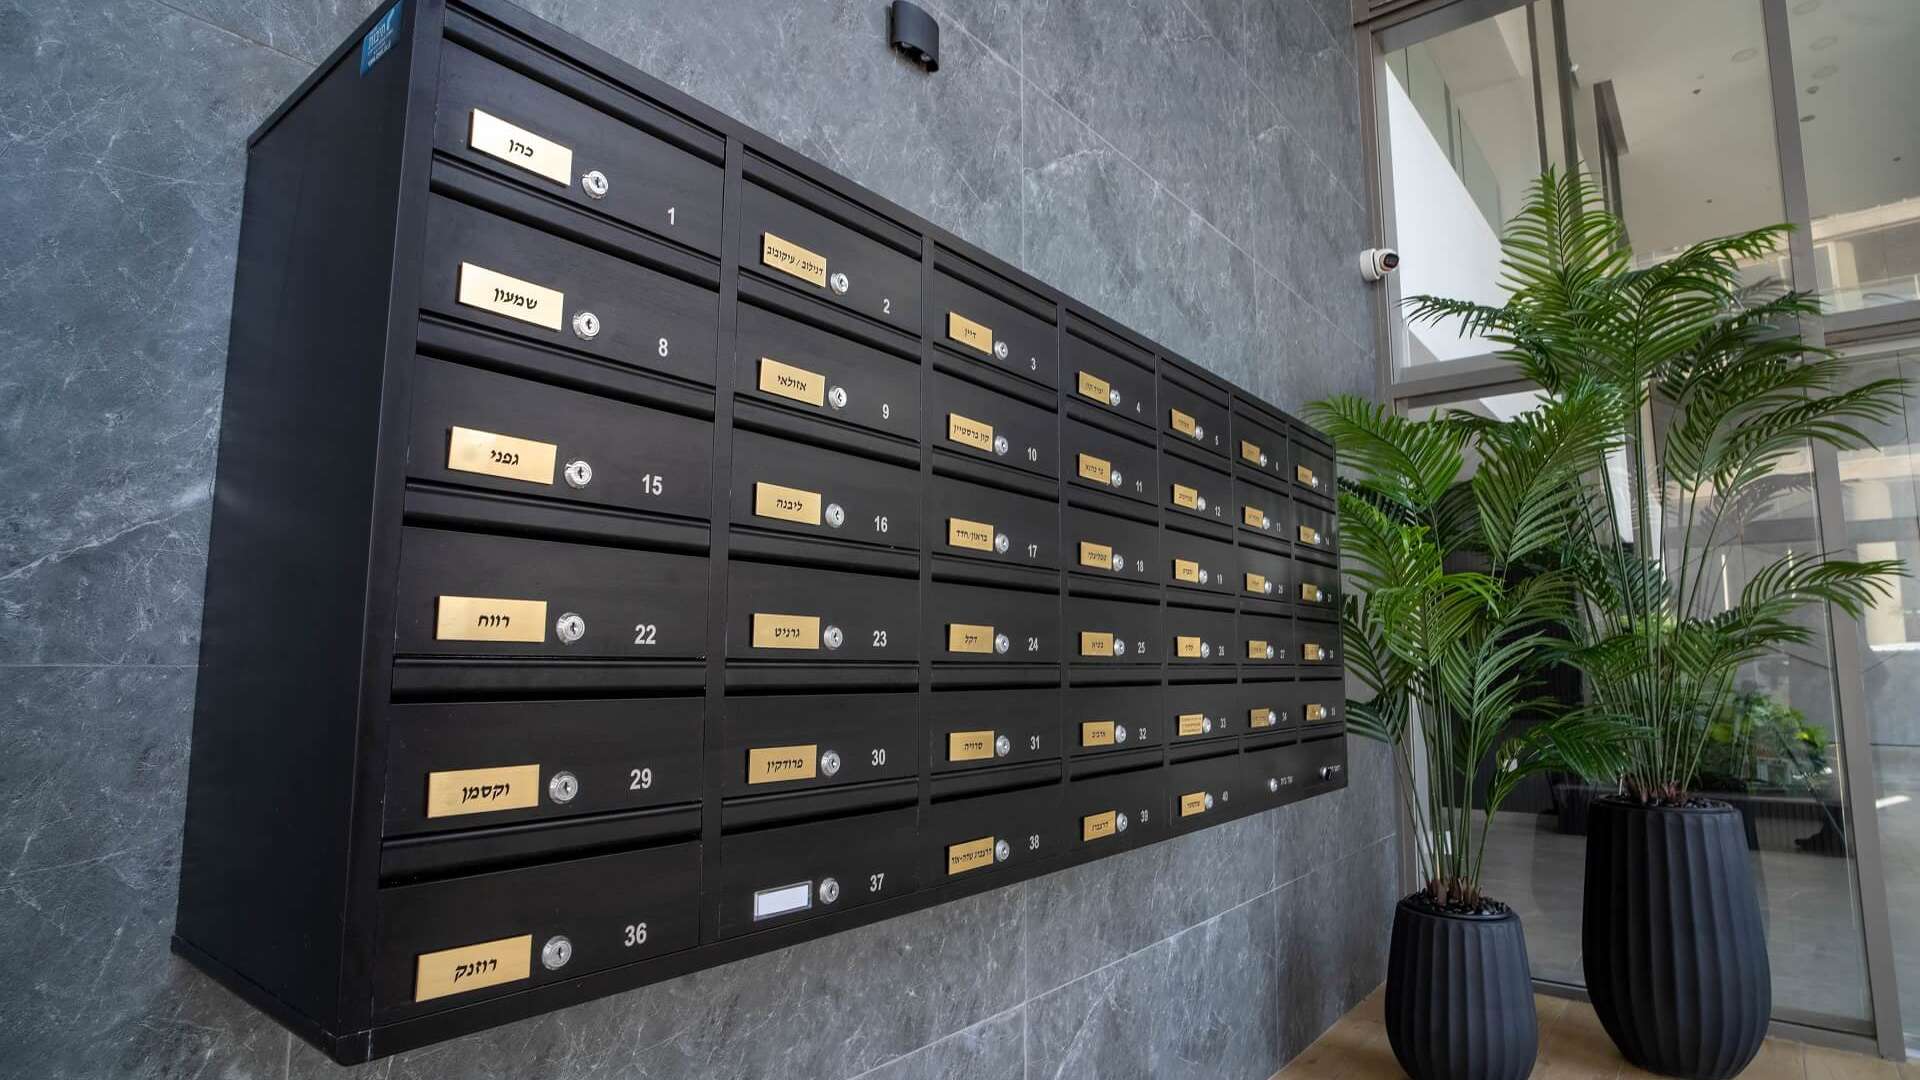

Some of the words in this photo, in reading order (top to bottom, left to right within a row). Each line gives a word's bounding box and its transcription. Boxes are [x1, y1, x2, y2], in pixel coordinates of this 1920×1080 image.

[509, 138, 534, 157] כהן
[668, 207, 675, 225] 1
[801, 261, 823, 277] דנילוב
[494, 288, 537, 309] שמעון
[883, 298, 890, 314] 2
[965, 329, 976, 339] דיין
[658, 338, 668, 357] 8
[1031, 358, 1036, 370] 3
[778, 375, 806, 391] אזולאי
[882, 404, 889, 419] 9
[1136, 401, 1141, 413] 4
[491, 450, 519, 465] גפני
[1028, 447, 1037, 461] 10
[642, 474, 662, 495] 15
[1136, 480, 1143, 493] 11
[777, 499, 802, 511] ליבנה
[1215, 505, 1221, 517] 12
[874, 515, 888, 532] 16
[1028, 544, 1037, 558] 17
[1136, 560, 1144, 573] 18
[478, 615, 510, 627] רווח
[635, 624, 656, 644] 22
[775, 628, 800, 638] גרניט
[873, 630, 887, 647] 23
[1028, 637, 1038, 651] 24
[1139, 727, 1147, 740] 32
[1030, 736, 1039, 750] 31
[767, 759, 803, 772] פרודקין
[872, 749, 885, 766] 30
[630, 768, 651, 790] 29
[462, 783, 510, 804] וקסמן
[1029, 834, 1039, 850] 38
[870, 873, 884, 892] 37
[624, 922, 647, 946] 36
[454, 958, 497, 980] רוזנק
